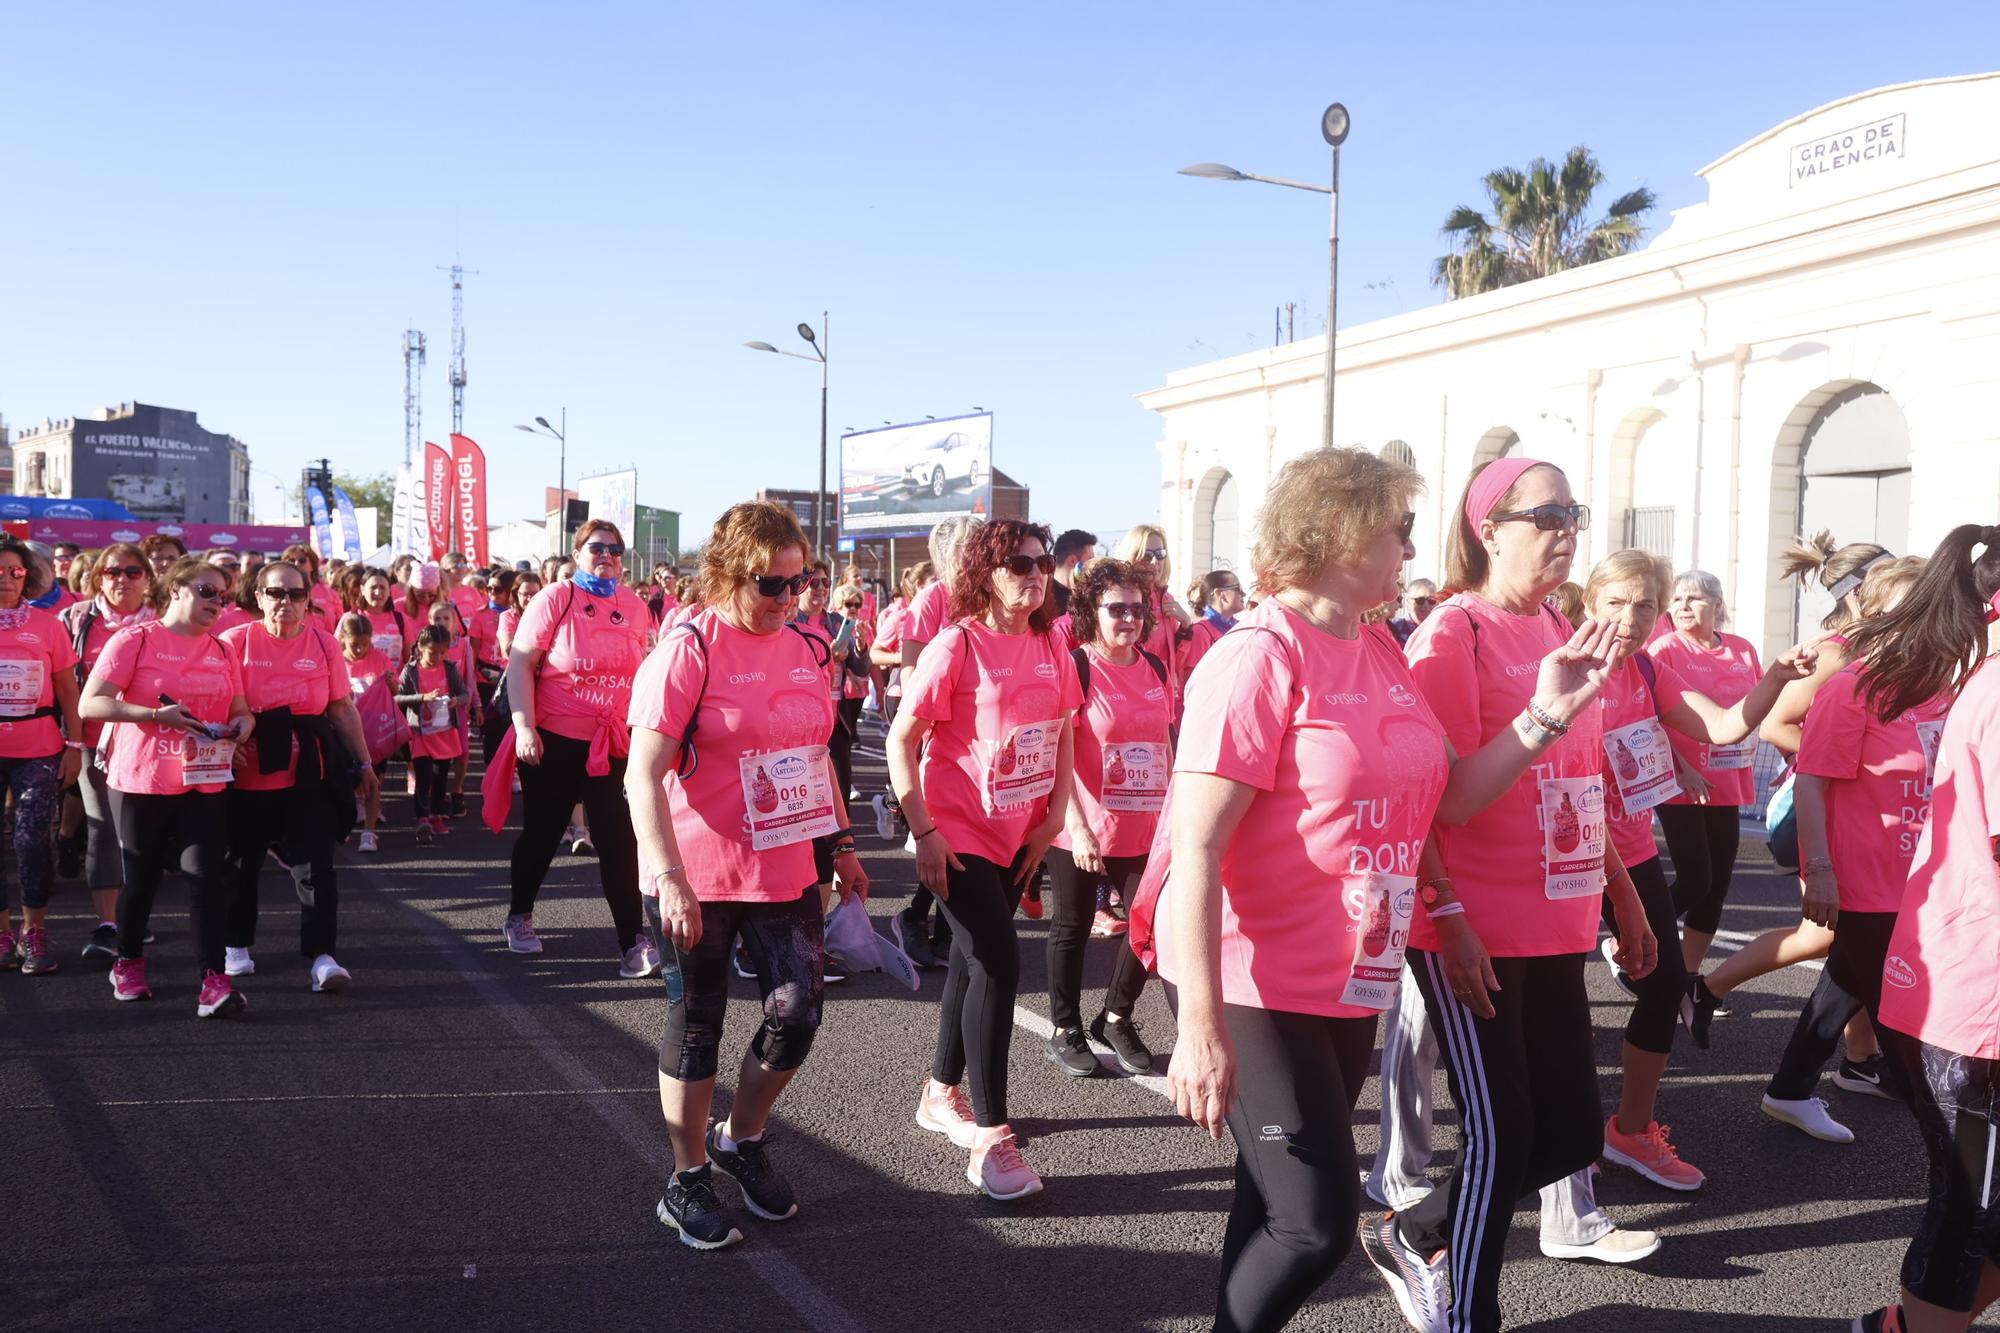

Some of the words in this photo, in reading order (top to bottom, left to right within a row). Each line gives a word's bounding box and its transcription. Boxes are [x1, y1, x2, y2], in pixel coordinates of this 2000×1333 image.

[1801, 136, 1853, 161] GRAO
[1865, 125, 1893, 144] DE
[1796, 141, 1896, 179] VALENCIA
[99, 434, 139, 447] PUERTO
[574, 658, 594, 671] TU
[729, 671, 767, 685] OYSHO
[1325, 693, 1367, 706] OYSHO
[199, 747, 217, 756] 016
[1018, 752, 1040, 766] 016
[1639, 752, 1656, 768] 016
[1128, 769, 1149, 779] 016
[780, 784, 808, 801] 016
[787, 801, 804, 812] 6835
[1352, 798, 1387, 830] TU
[807, 822, 831, 831] Santander
[1582, 822, 1603, 840] 016
[762, 831, 789, 843] OYSHO
[1588, 843, 1601, 854] 1782
[1350, 840, 1420, 875] DORS
[1560, 862, 1586, 871] CARRERA
[1556, 879, 1587, 890] OYSHO
[1364, 970, 1389, 978] CARRERA
[1354, 986, 1386, 999] OYSHO
